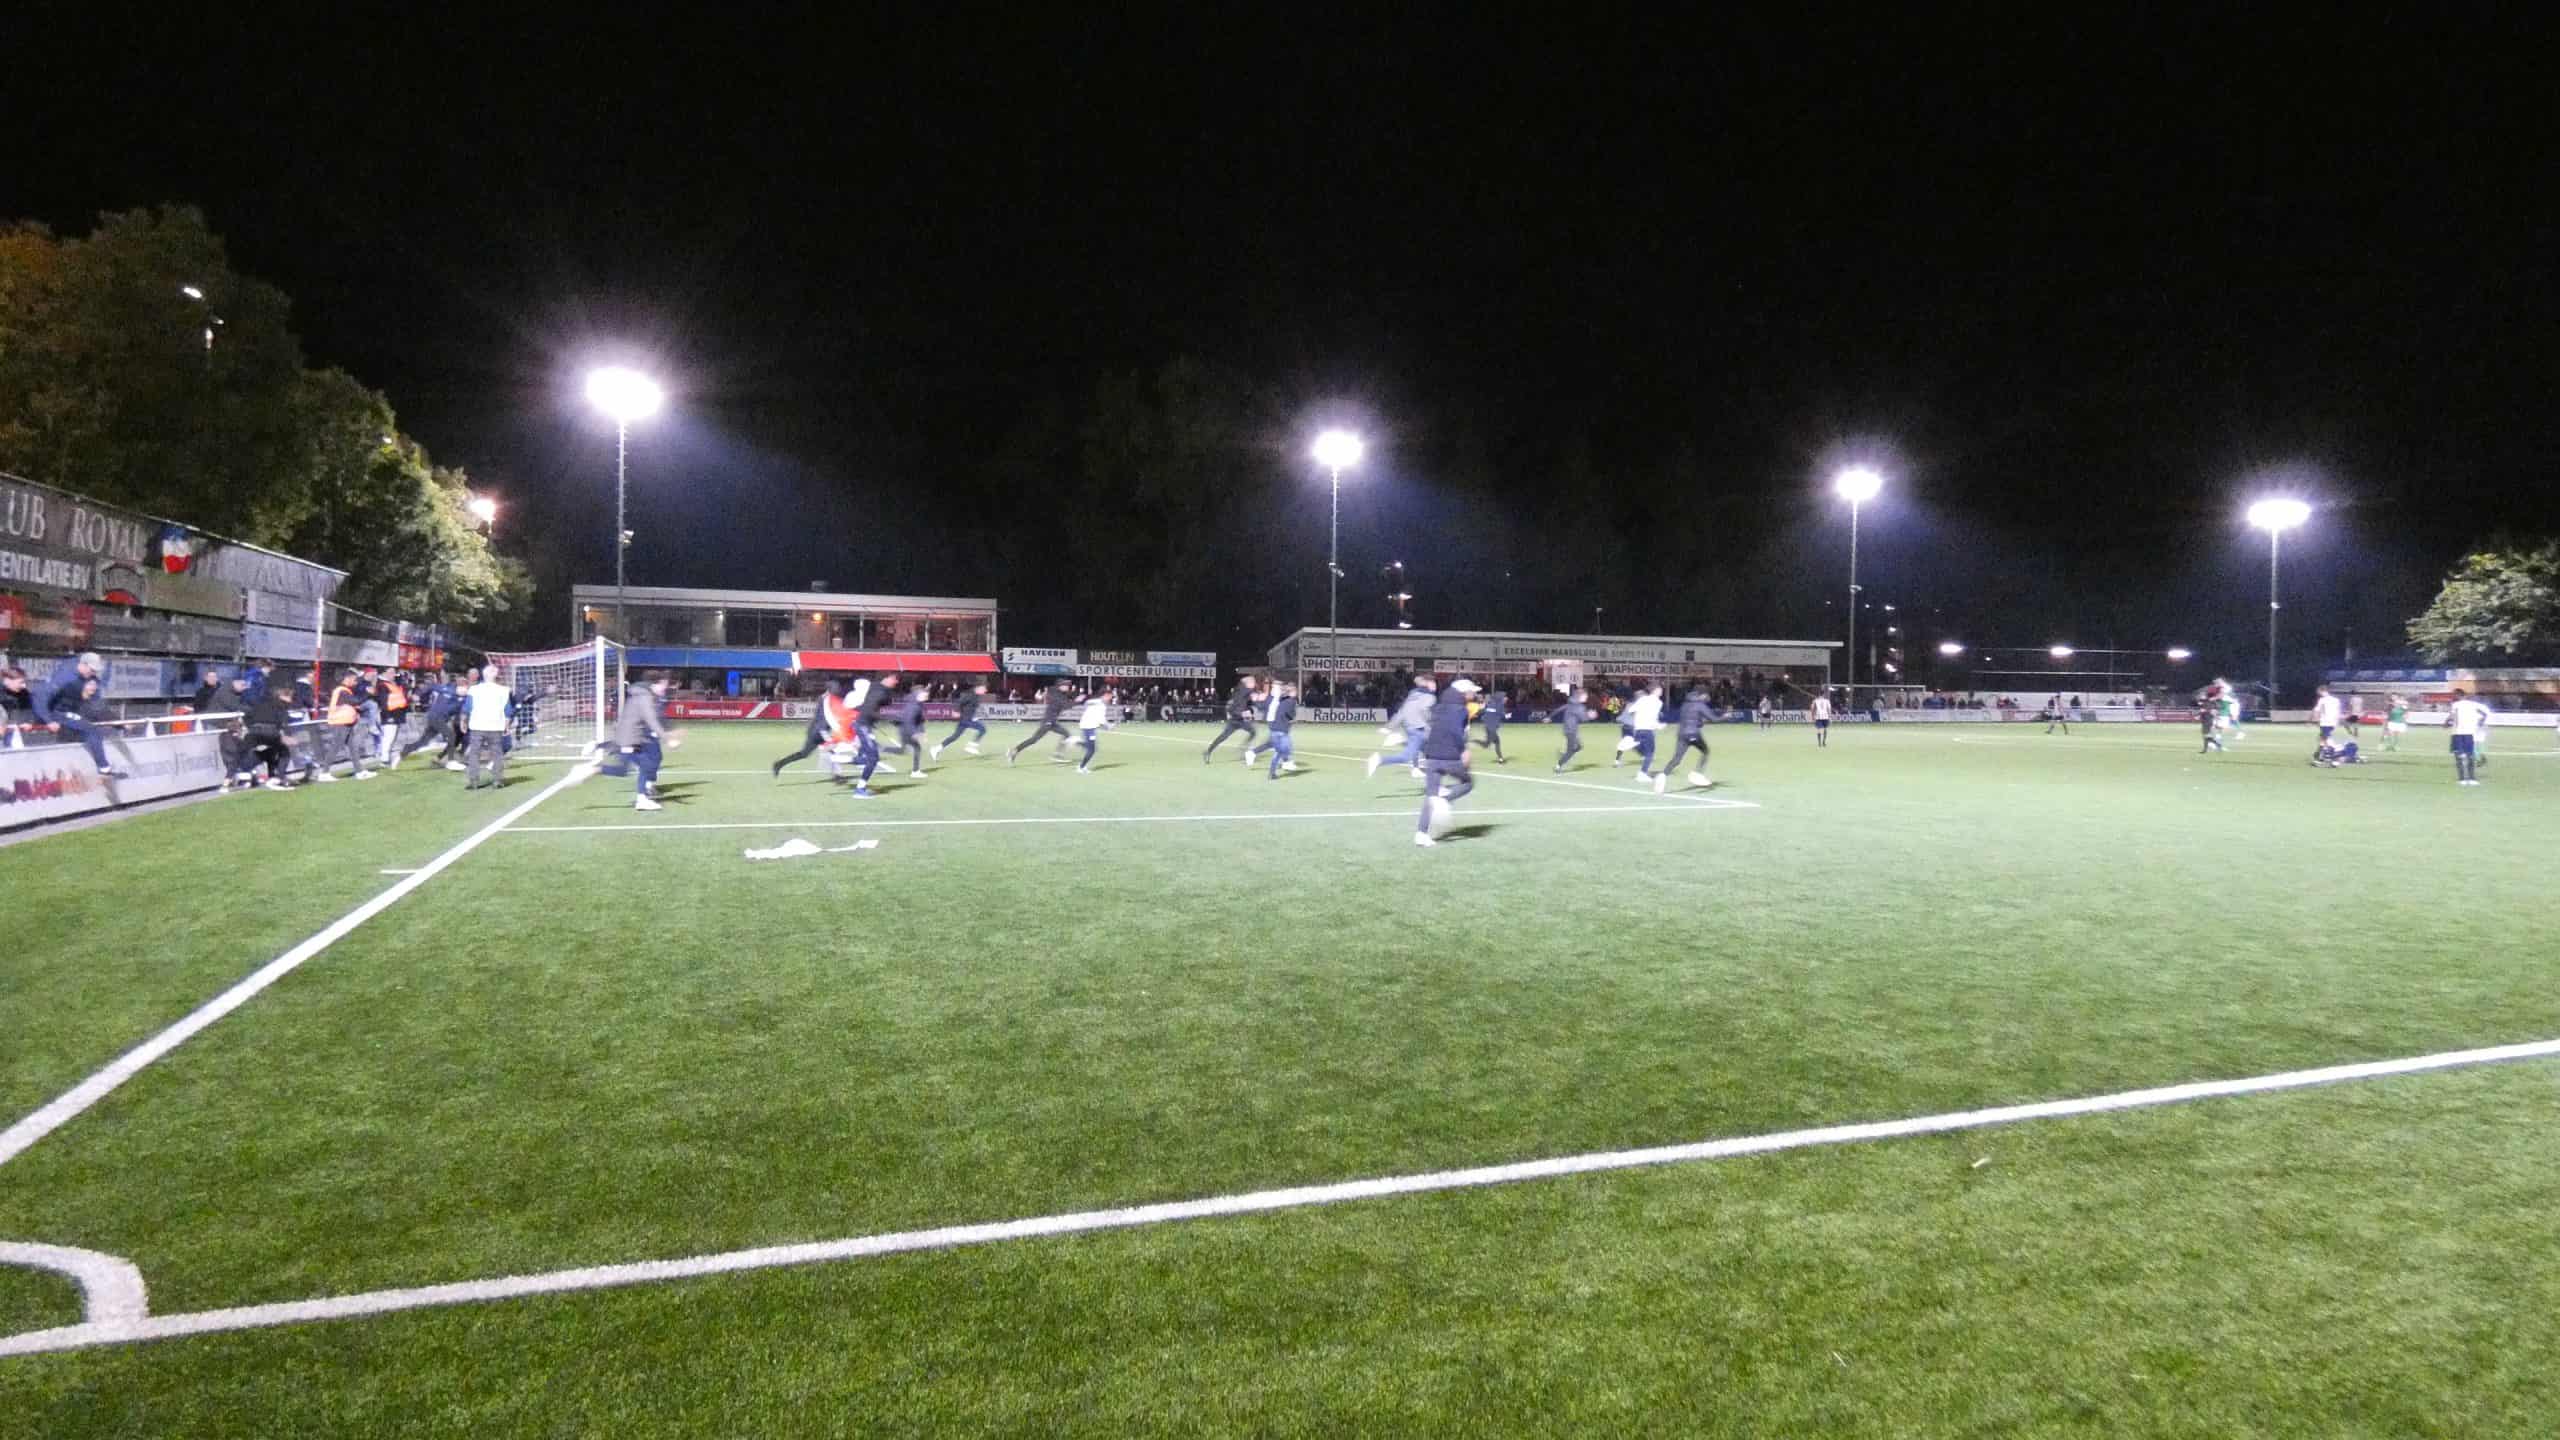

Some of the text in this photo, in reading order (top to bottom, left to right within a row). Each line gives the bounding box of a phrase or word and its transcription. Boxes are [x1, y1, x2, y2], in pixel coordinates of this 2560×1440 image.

[0, 488, 146, 563] UB ROYAL
[1313, 708, 1377, 721] Rabobank
